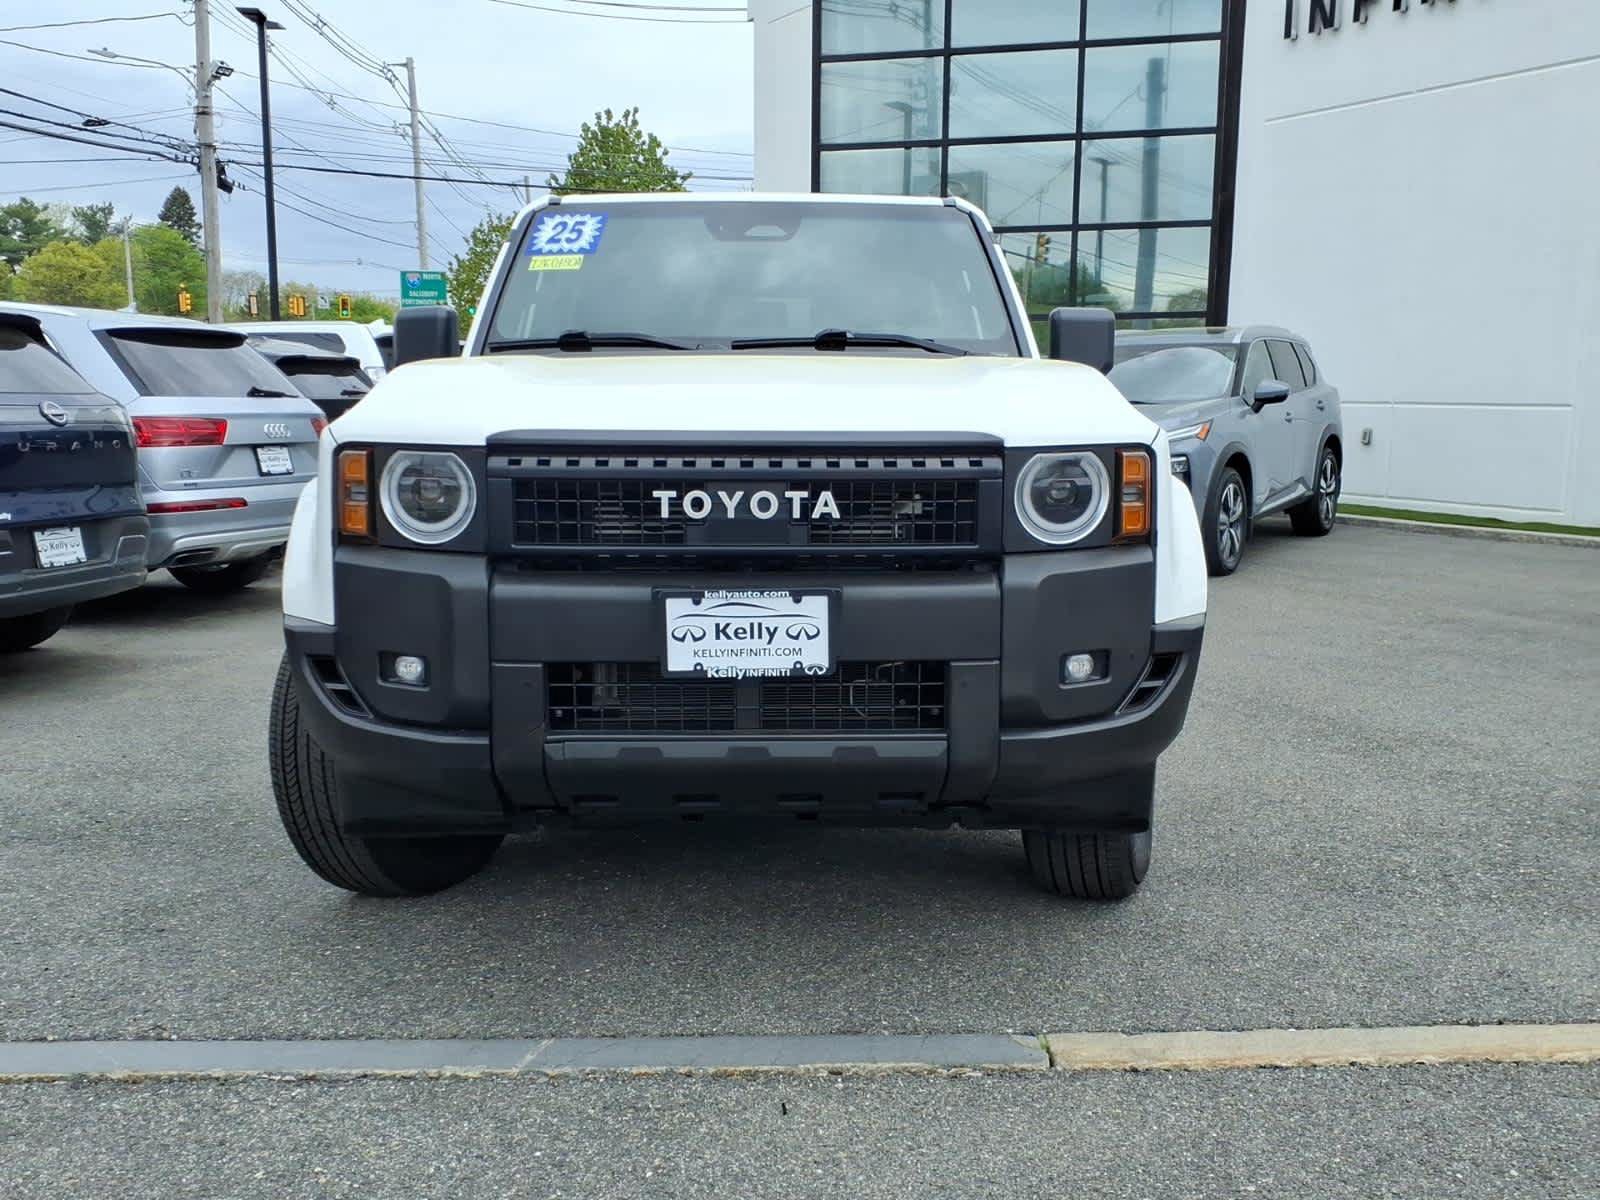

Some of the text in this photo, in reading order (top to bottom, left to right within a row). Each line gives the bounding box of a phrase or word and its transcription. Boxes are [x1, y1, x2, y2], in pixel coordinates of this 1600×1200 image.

[546, 221, 588, 245] 25
[652, 490, 841, 519] TOYOTA
[49, 542, 68, 551] Kelly
[704, 590, 790, 599] kellyauto.com
[714, 622, 779, 645] Kelly
[693, 647, 802, 657] KELLYINFINITI.COM
